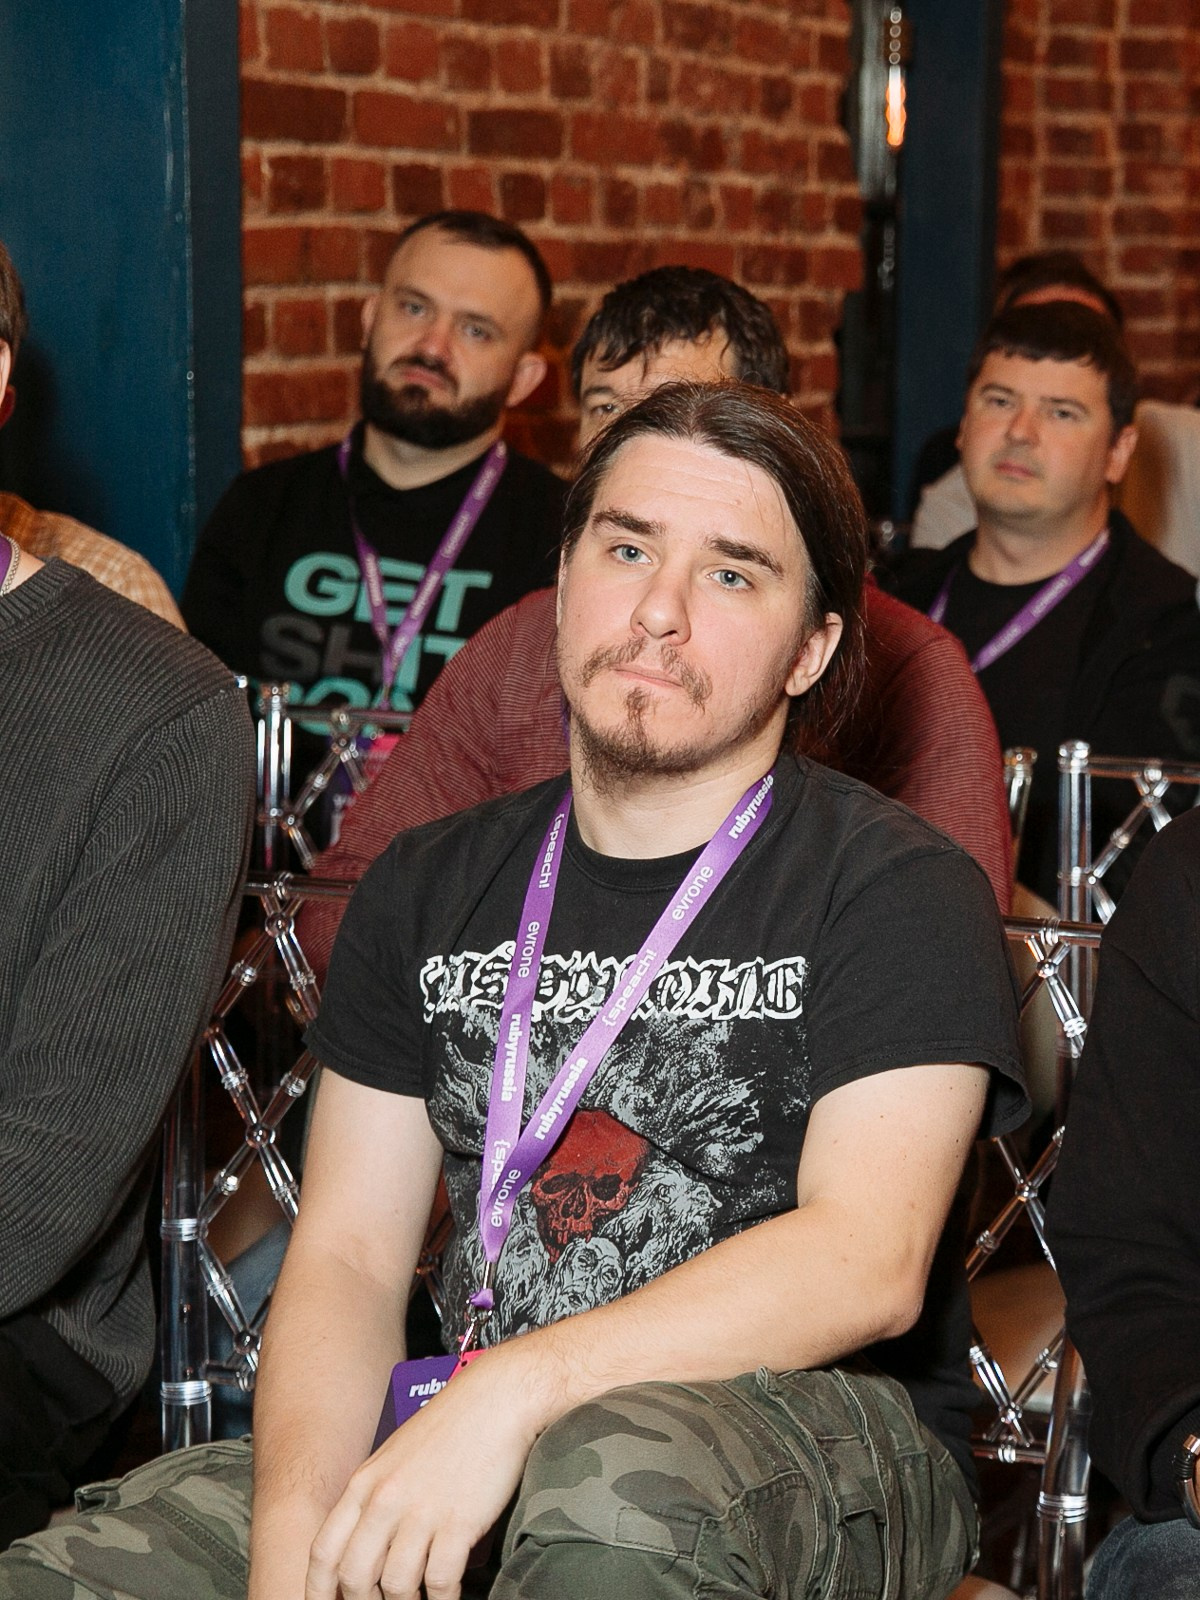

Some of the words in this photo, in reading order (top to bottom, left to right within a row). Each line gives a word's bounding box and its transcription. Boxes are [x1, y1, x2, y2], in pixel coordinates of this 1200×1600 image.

[284, 551, 493, 632] GET
[517, 921, 540, 978] evrone
[490, 1168, 521, 1228] evrone
[534, 1056, 588, 1141] rubyrussia
[671, 865, 714, 921] evrone
[728, 774, 774, 839] rubyrussia
[501, 1013, 523, 1102] rubyrussia
